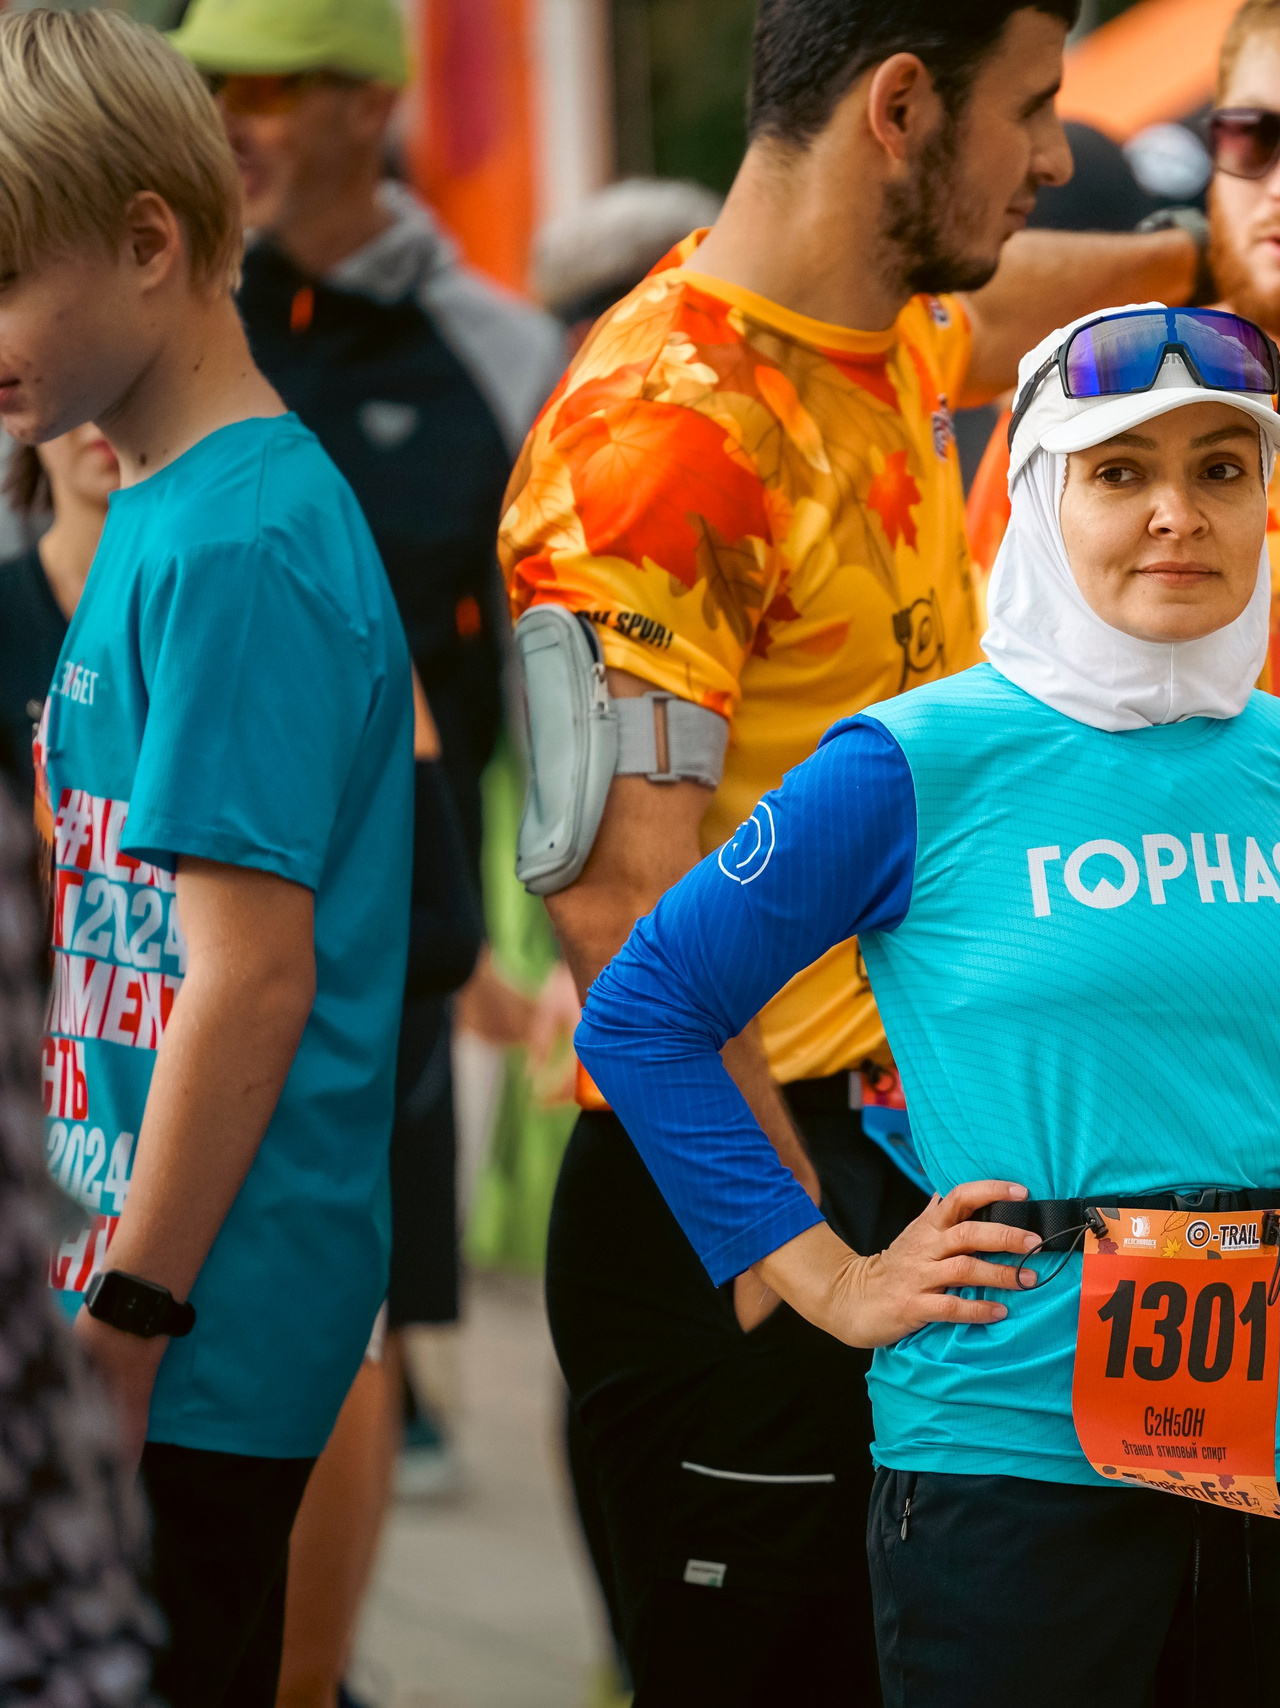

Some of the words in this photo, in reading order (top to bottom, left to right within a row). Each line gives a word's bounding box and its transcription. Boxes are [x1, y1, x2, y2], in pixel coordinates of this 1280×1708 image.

[1097, 1279, 1268, 1383] 1301
[1144, 1405, 1206, 1438] C2H5OH
[1122, 1440, 1154, 1456] Этанол
[1157, 1442, 1199, 1460] этиловый
[1202, 1446, 1227, 1463] спирт
